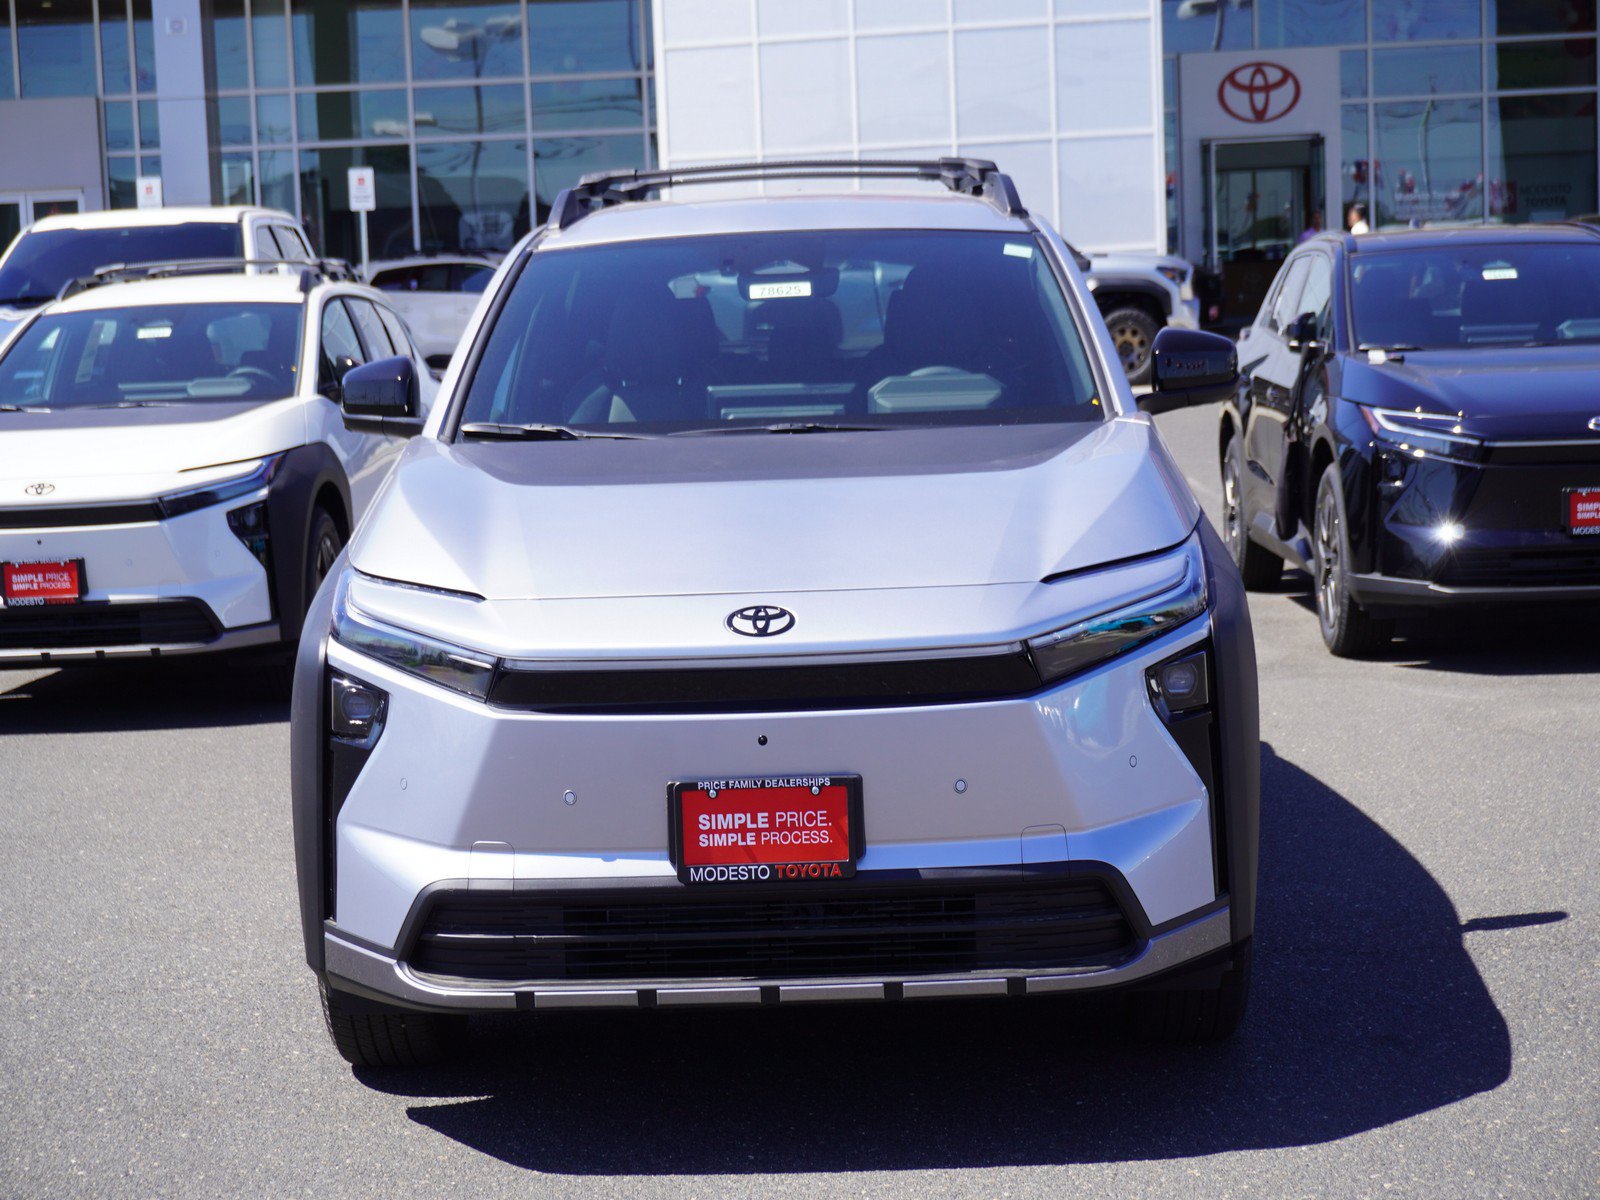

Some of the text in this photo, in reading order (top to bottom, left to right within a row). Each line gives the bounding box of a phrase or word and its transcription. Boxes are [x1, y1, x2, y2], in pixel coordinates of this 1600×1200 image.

[760, 286, 801, 297] 78625
[1577, 503, 1600, 511] SIMP
[12, 573, 44, 583] SIMPLE
[12, 582, 38, 591] SIMPLE
[7, 597, 45, 606] MODESTO
[698, 777, 831, 790] PRICE FAMILY DEALERSHIPS
[698, 810, 832, 830] SIMPLE PRICE.
[699, 830, 833, 847] SIMPLE PROCESS.
[690, 863, 842, 882] MODESTO TOYOTA
